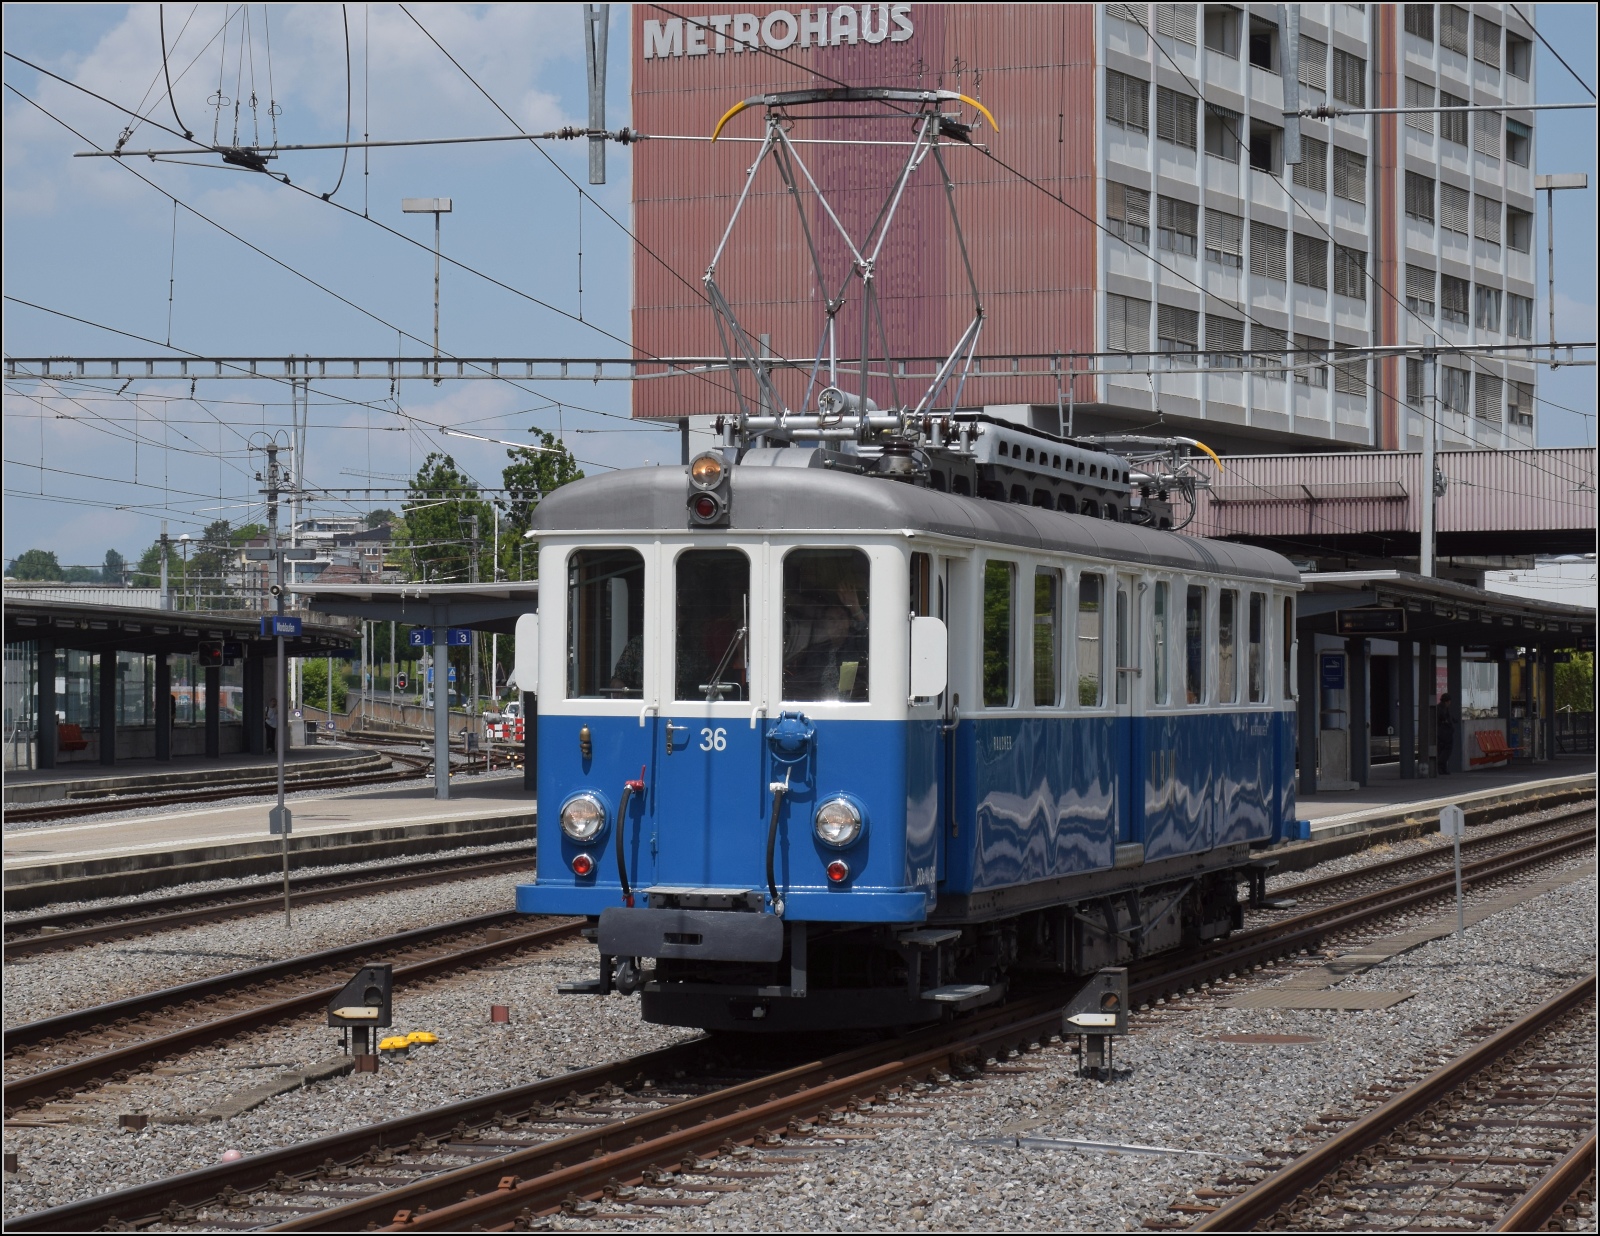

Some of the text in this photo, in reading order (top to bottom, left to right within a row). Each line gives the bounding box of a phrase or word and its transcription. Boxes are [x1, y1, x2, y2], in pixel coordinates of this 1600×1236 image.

[644, 4, 914, 58] METROHAUS
[414, 634, 421, 643] 2
[460, 634, 467, 643] 3
[700, 727, 727, 751] 36
